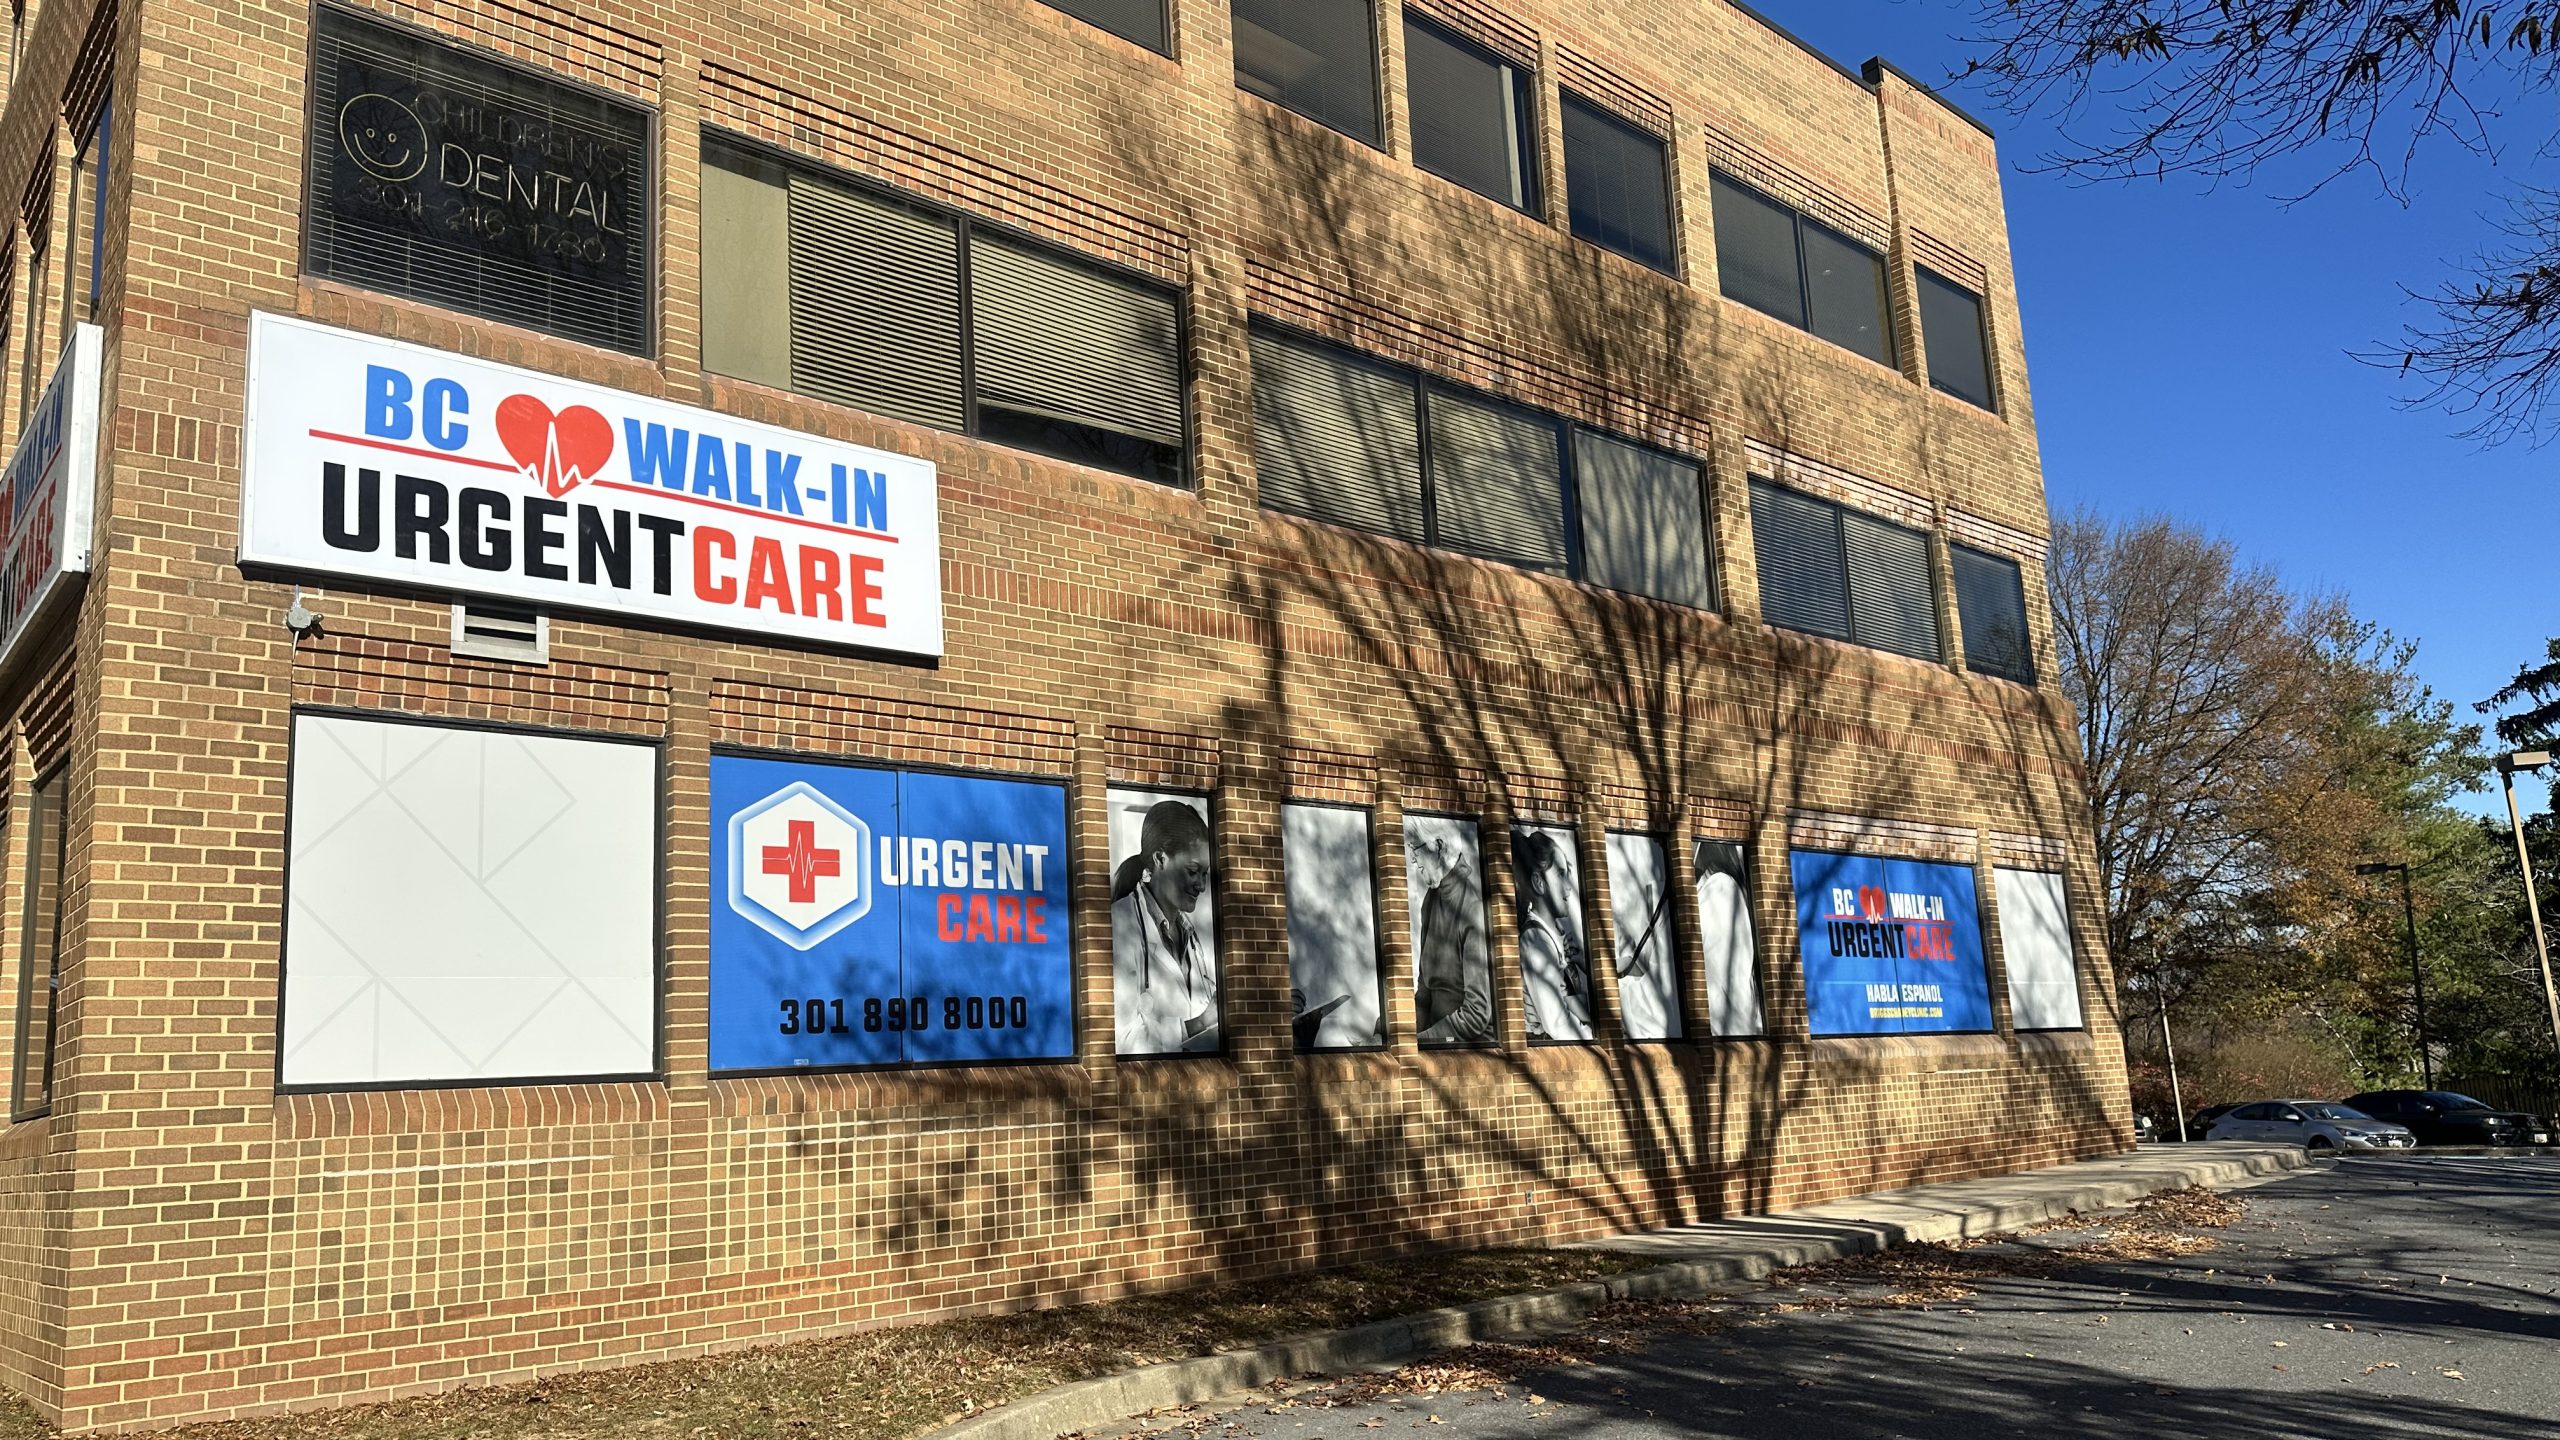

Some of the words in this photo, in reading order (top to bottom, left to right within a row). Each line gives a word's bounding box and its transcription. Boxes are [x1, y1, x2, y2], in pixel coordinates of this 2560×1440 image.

[439, 142, 625, 235] DENTAL
[13, 374, 65, 528] WALK-IN
[364, 363, 469, 451] BC
[623, 417, 887, 531] WALK-IN
[880, 836, 1049, 891] URGENT
[937, 893, 1047, 944] CARE
[1832, 887, 1855, 916] BC
[1889, 892, 1945, 921] WALK-IN
[779, 998, 849, 1035] 301
[863, 997, 929, 1033] 890
[943, 996, 1027, 1029] 8000
[1865, 983, 1899, 1003] HABLA
[1901, 984, 1943, 1003] ESPANOL
